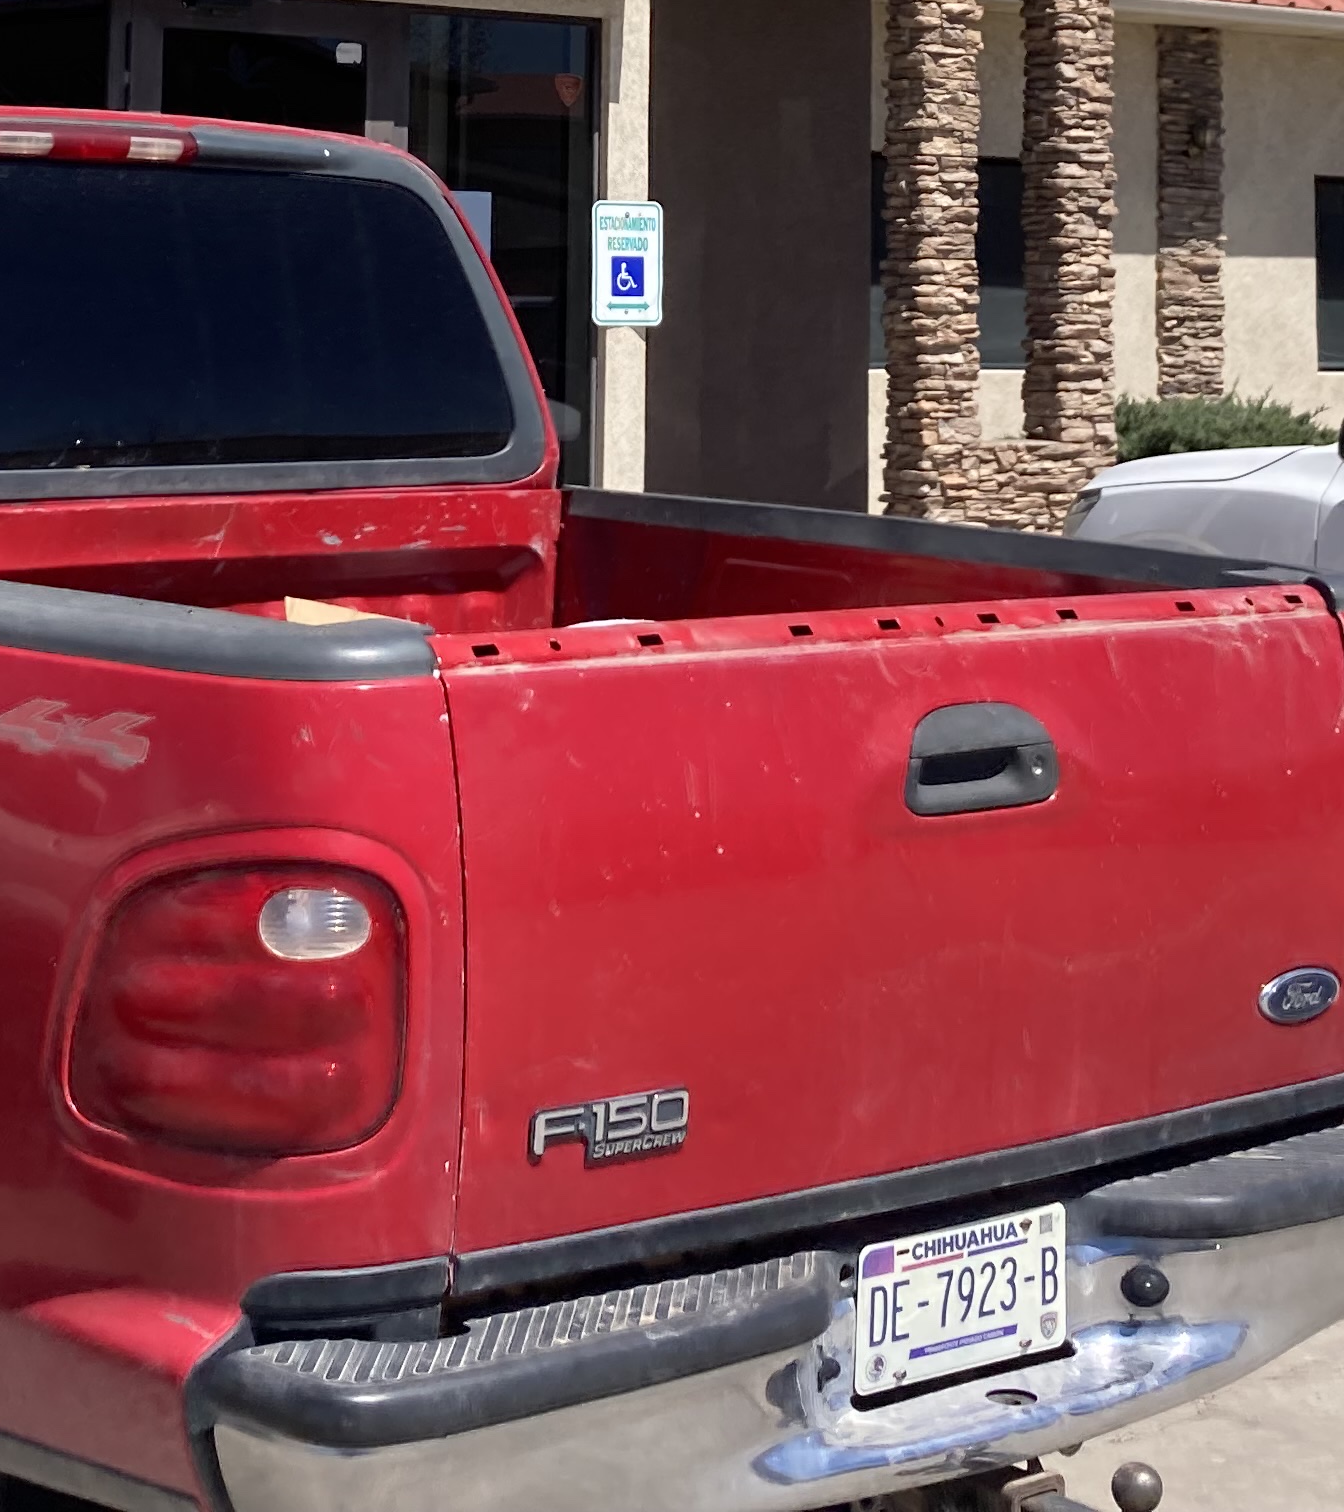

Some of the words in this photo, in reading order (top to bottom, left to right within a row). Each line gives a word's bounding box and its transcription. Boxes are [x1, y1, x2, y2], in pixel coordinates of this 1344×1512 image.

[599, 216, 656, 231] ESTACIONAMIENTO
[607, 236, 649, 251] RESERVADO
[1282, 981, 1323, 1010] Ford
[911, 1221, 1018, 1261] CHIHUAHUA
[868, 1245, 1058, 1348] DE-7923-B
